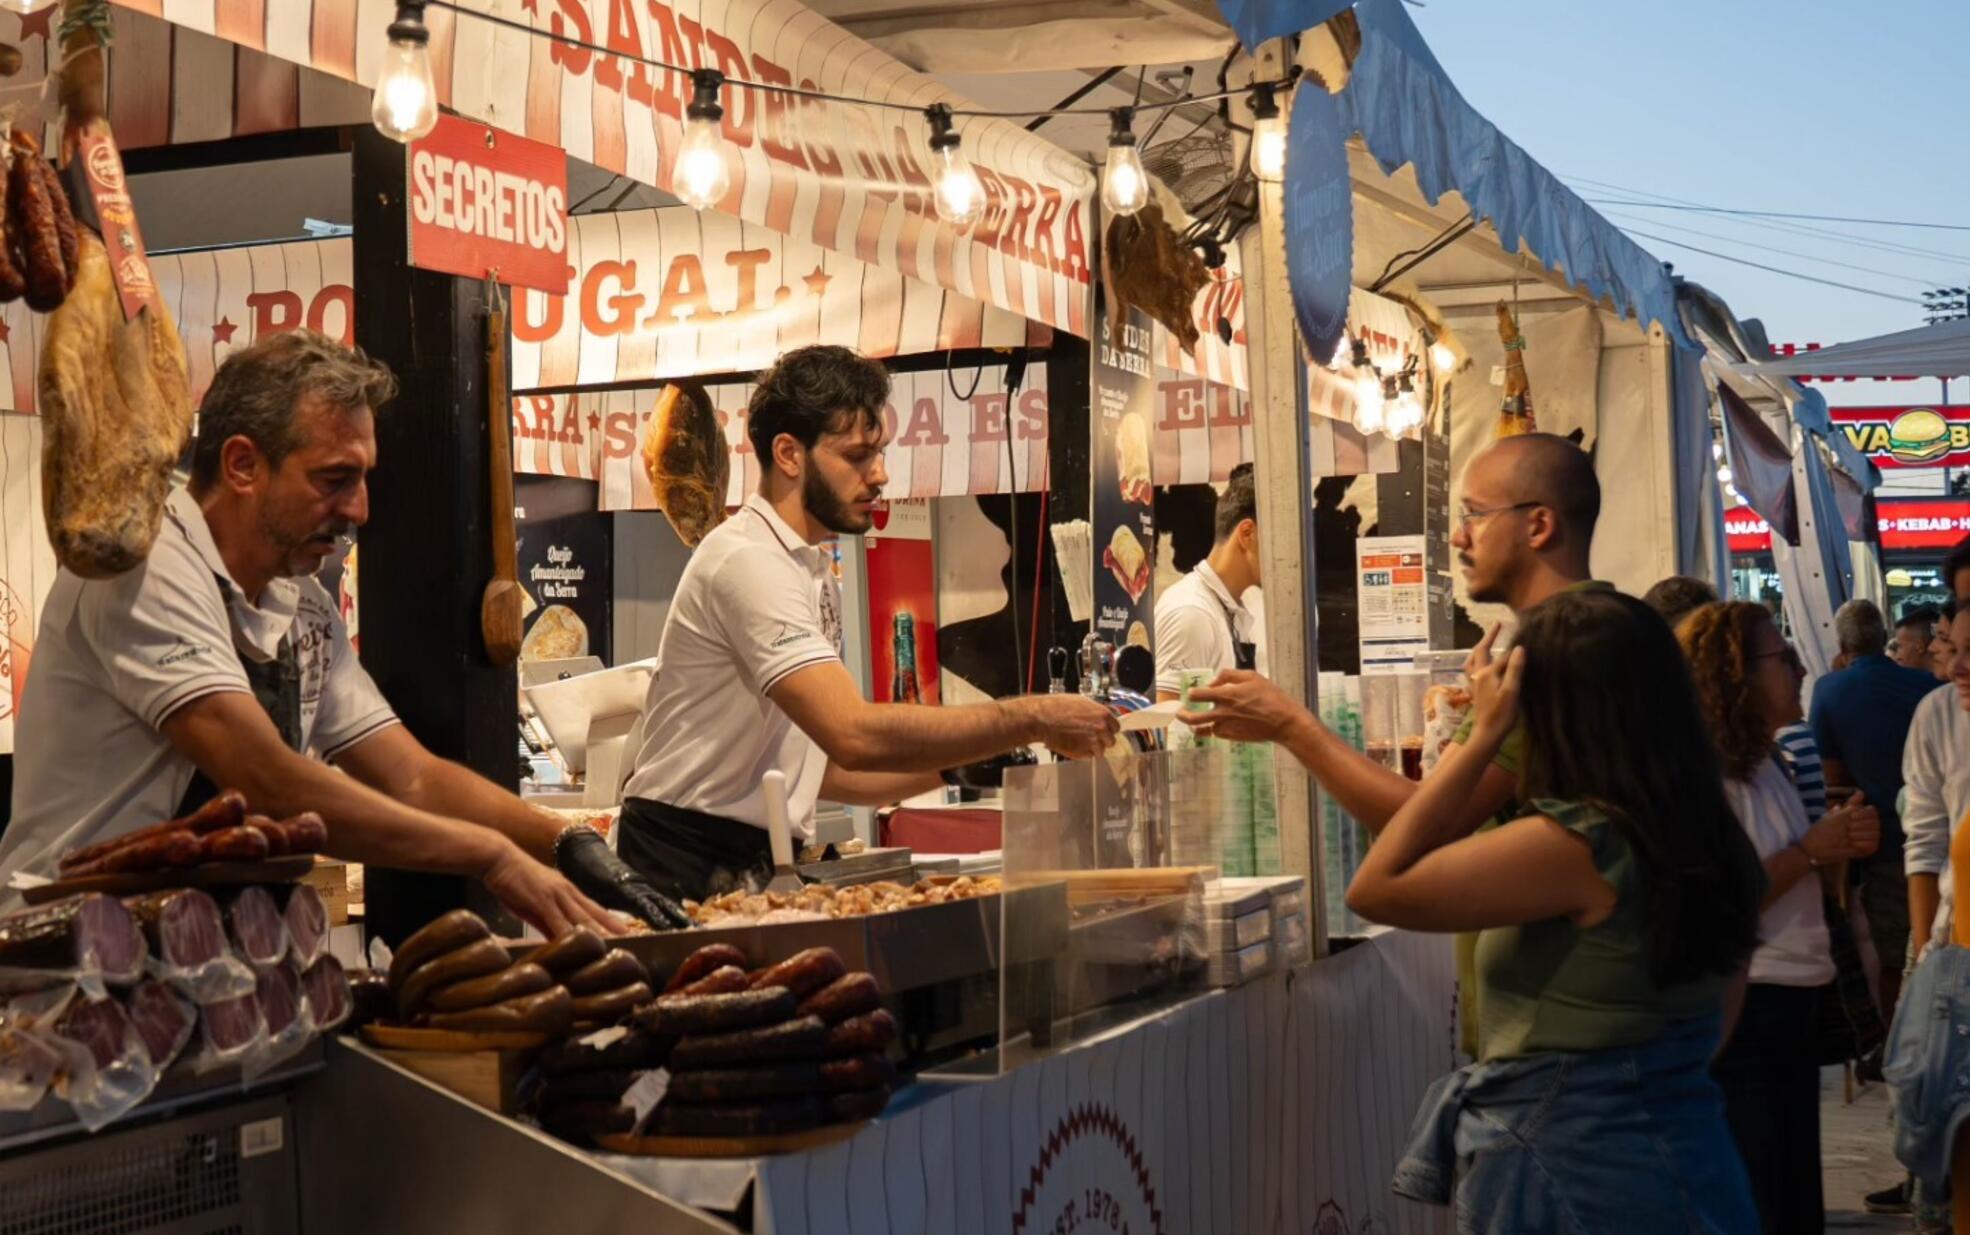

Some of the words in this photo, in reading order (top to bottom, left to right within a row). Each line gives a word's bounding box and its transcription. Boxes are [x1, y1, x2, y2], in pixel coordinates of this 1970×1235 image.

[412, 150, 566, 254] SECRETOS
[957, 162, 1091, 286] ERRA
[1896, 517, 1952, 531] KEBAB
[1085, 1188, 1121, 1231] 1978
